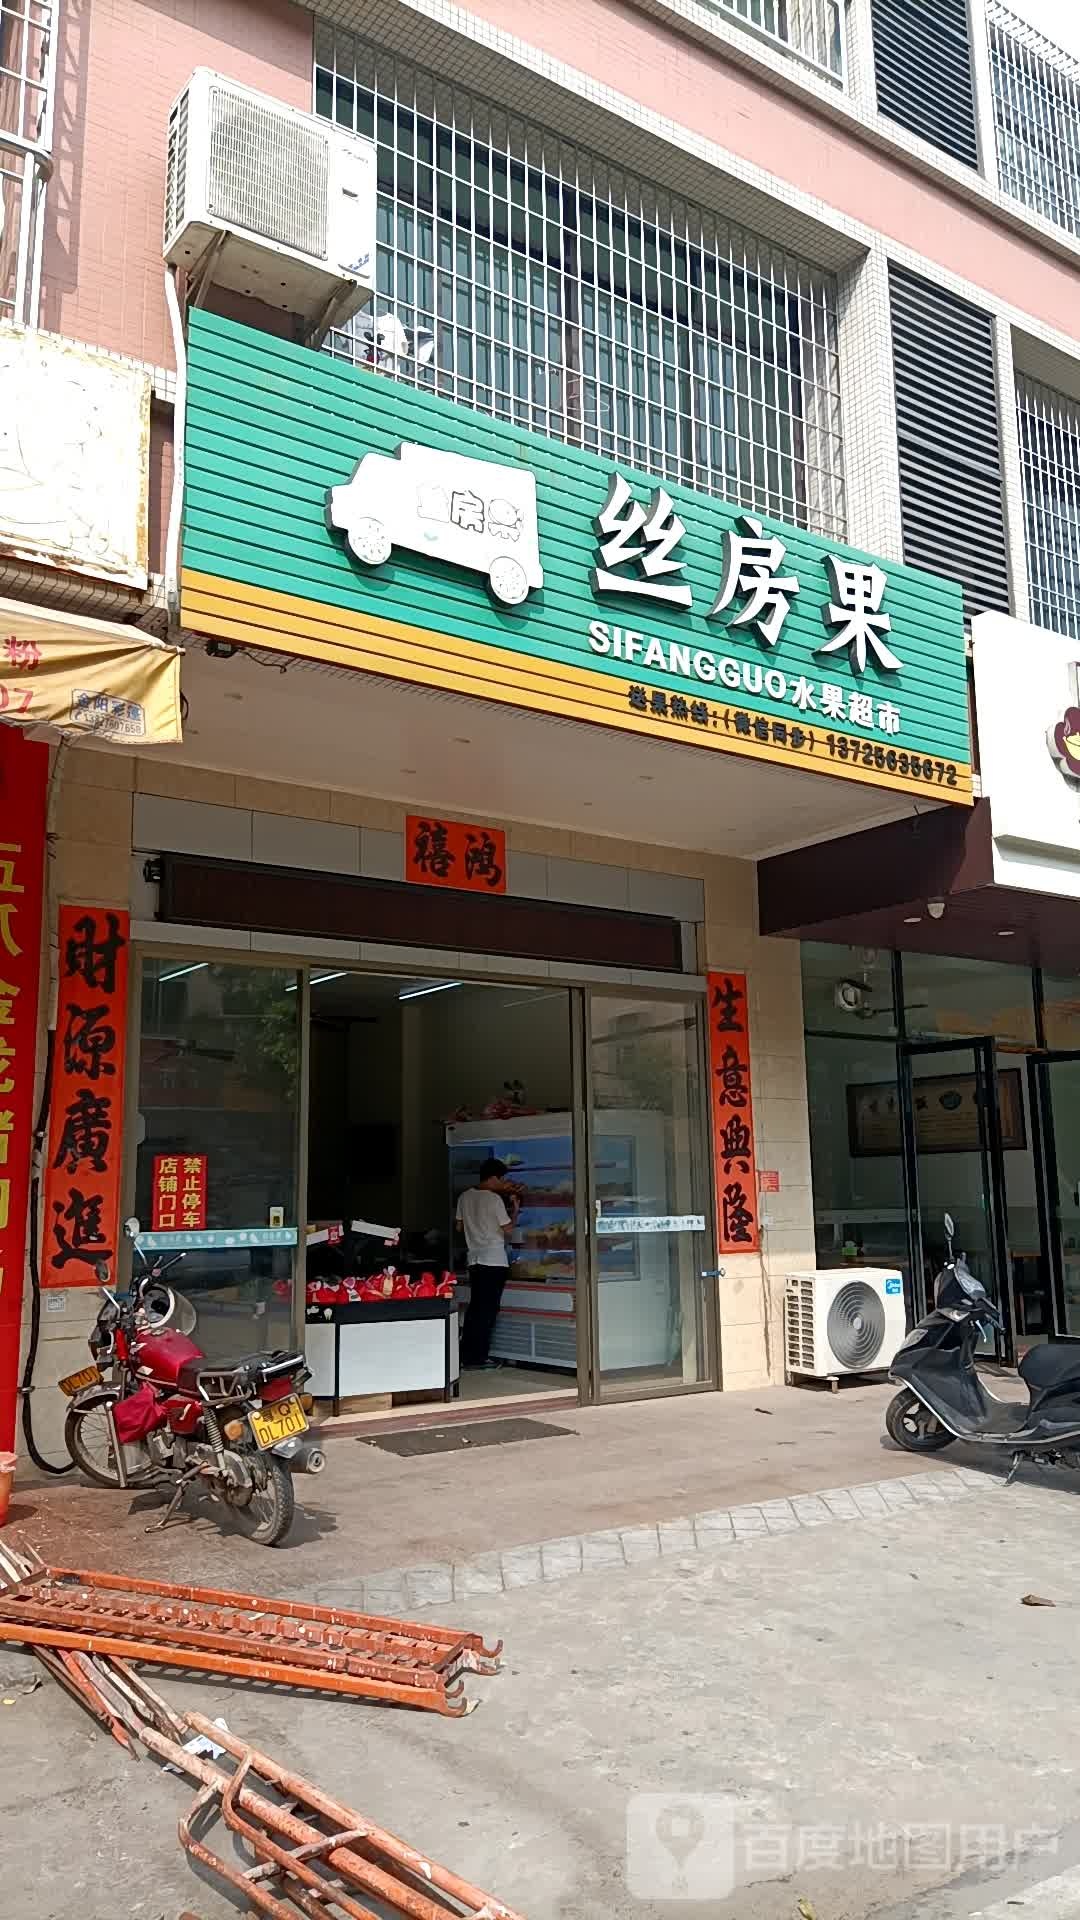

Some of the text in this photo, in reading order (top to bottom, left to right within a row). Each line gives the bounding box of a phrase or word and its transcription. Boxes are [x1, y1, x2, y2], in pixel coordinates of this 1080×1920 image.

[593, 471, 905, 675] 丝房果
[3, 635, 42, 670] 粉
[791, 676, 901, 736] 水果超市
[158, 1157, 178, 1228] 店铺门口
[182, 1157, 202, 1228] 禁止停车
[259, 1412, 302, 1444] DL701
